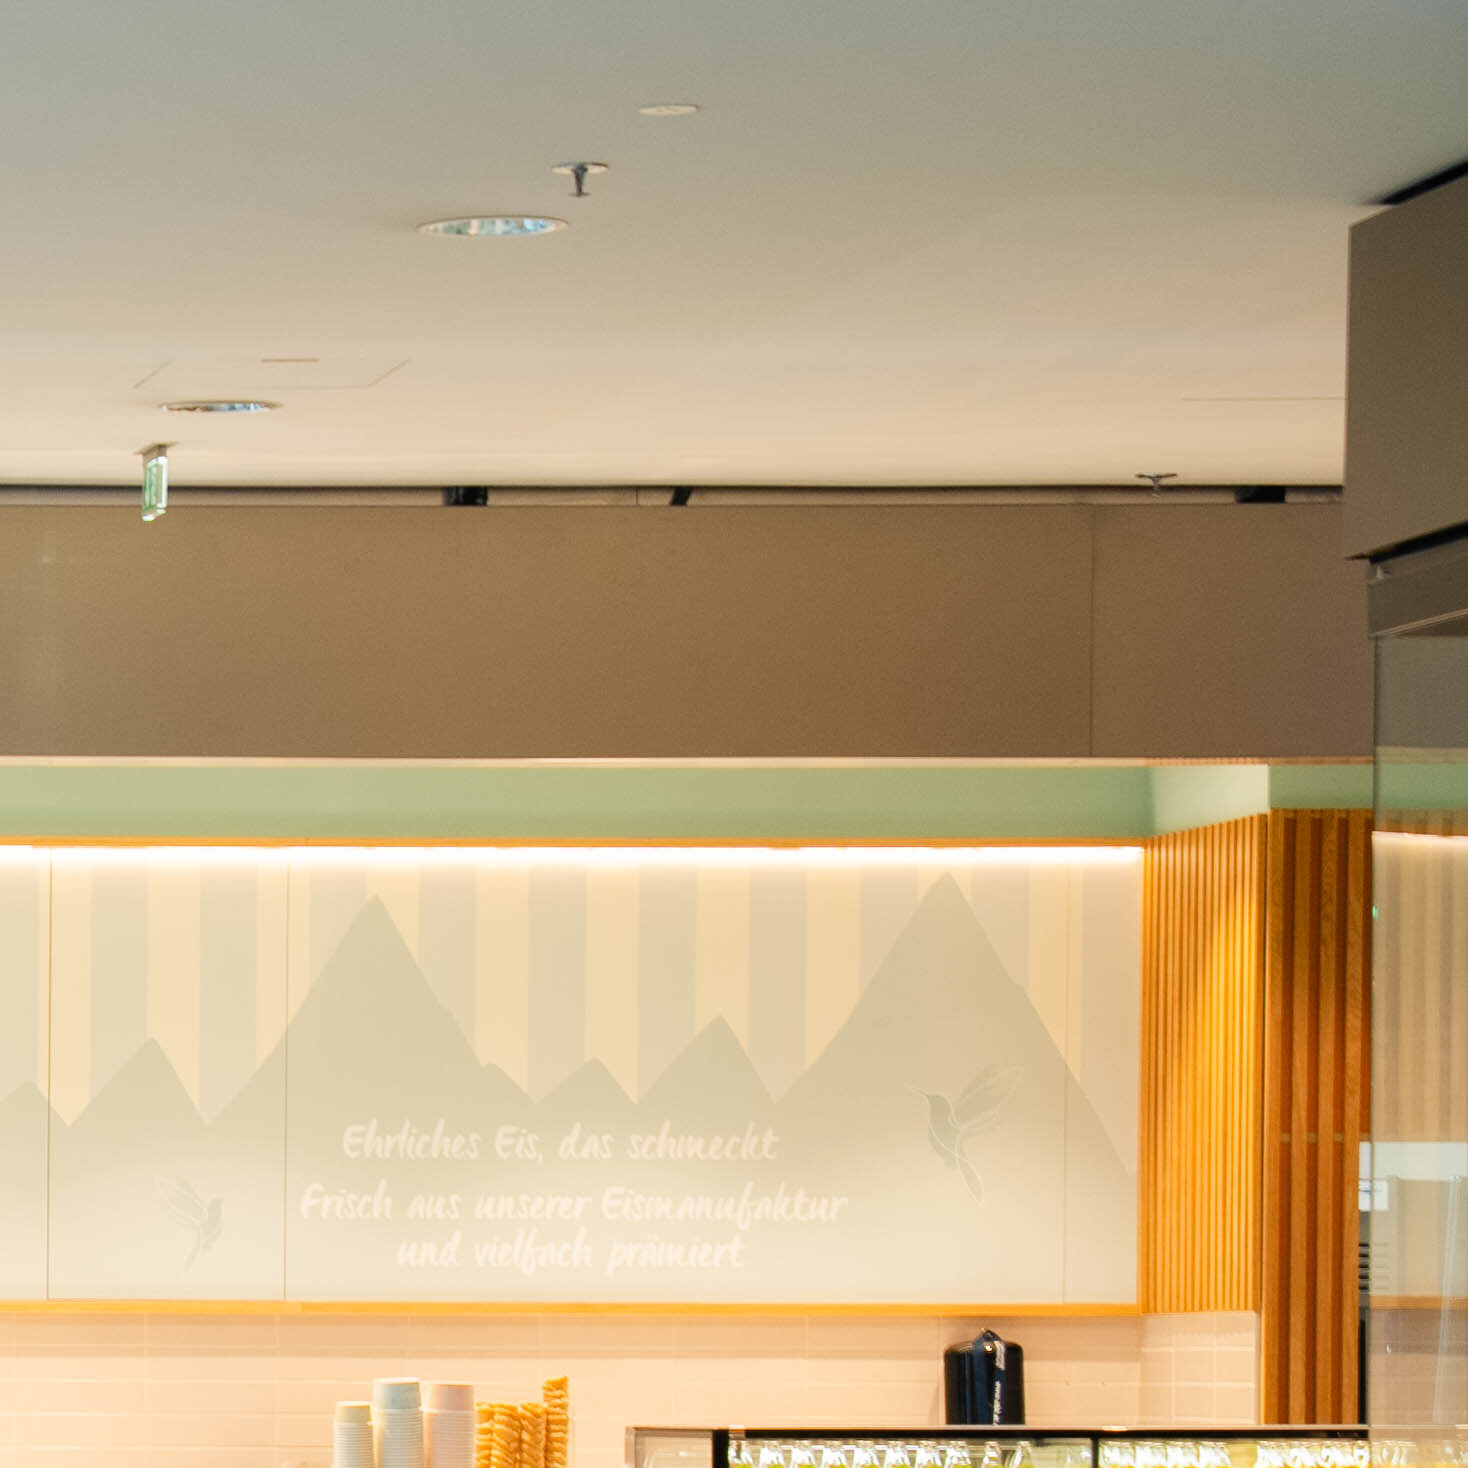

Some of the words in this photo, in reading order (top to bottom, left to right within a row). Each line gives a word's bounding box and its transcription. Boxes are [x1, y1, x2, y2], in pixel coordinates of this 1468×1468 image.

[342, 1117, 480, 1161] Ehrliches
[494, 1124, 545, 1165] Eis,
[558, 1122, 614, 1161] das
[628, 1120, 780, 1163] schmeckt
[300, 1181, 392, 1222] Frisch
[408, 1191, 461, 1222] aus
[475, 1189, 592, 1222] unserer
[601, 1181, 848, 1231] Eismanufaktur
[396, 1232, 459, 1269] und
[474, 1231, 593, 1275] vielfach
[608, 1230, 747, 1277] prämiert
